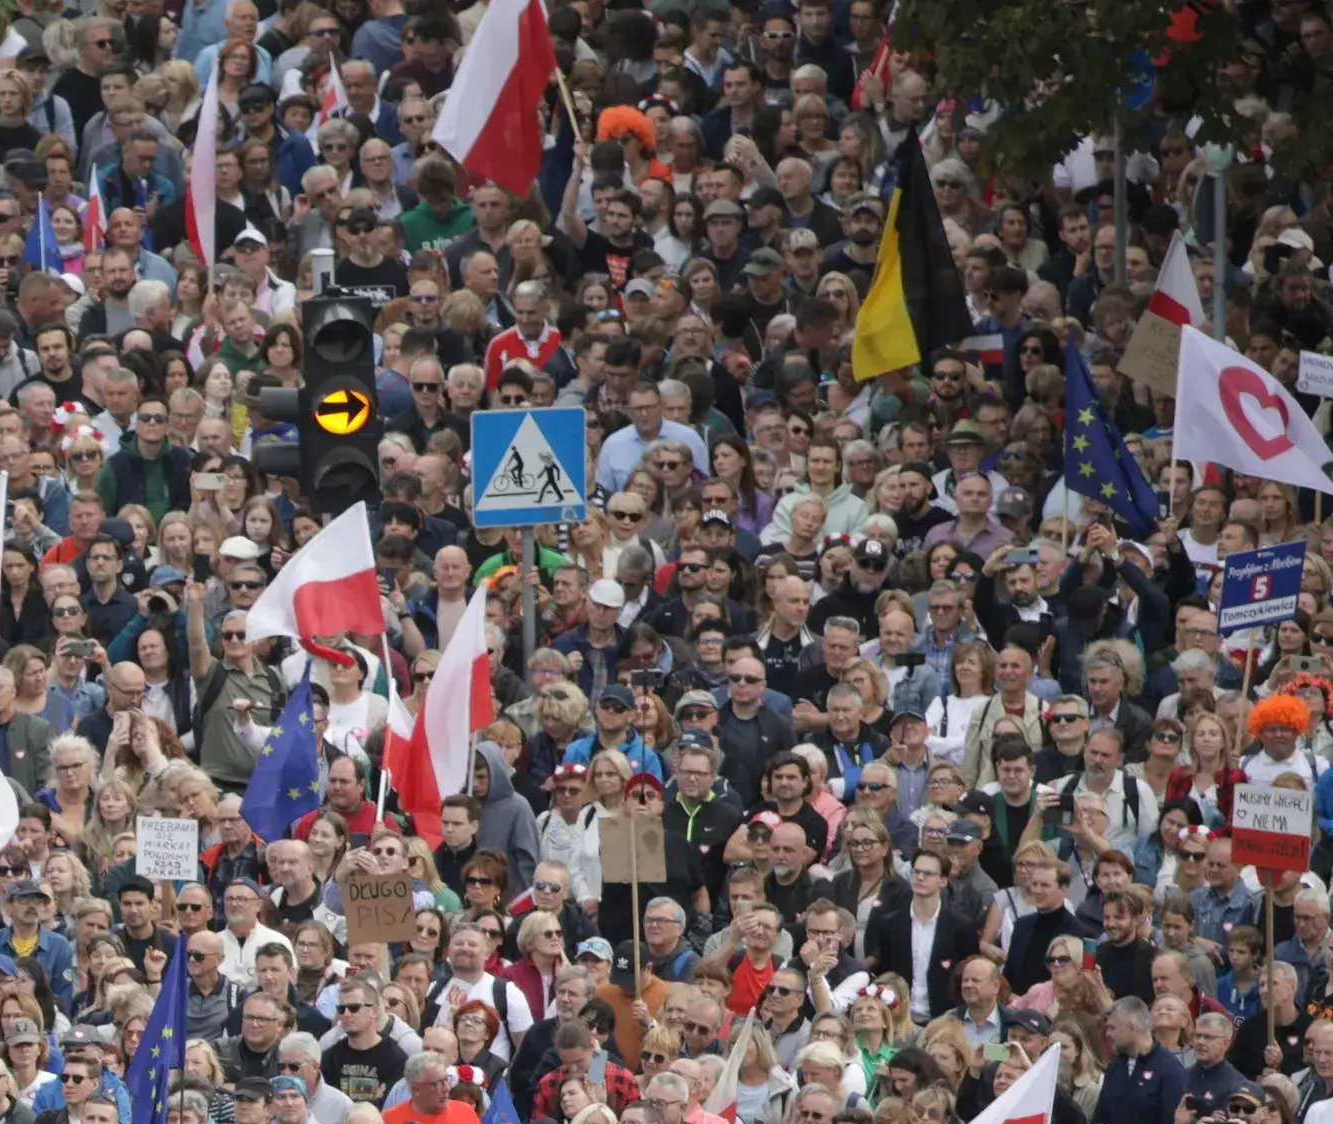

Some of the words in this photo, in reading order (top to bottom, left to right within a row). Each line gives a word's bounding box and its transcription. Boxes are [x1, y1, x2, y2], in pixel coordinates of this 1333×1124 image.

[1254, 576, 1268, 600] 5
[1223, 600, 1294, 622] Tomczykiewicz
[1239, 791, 1271, 806] MUSIMY
[1273, 815, 1288, 833] MA
[349, 880, 408, 902] DŁUGO
